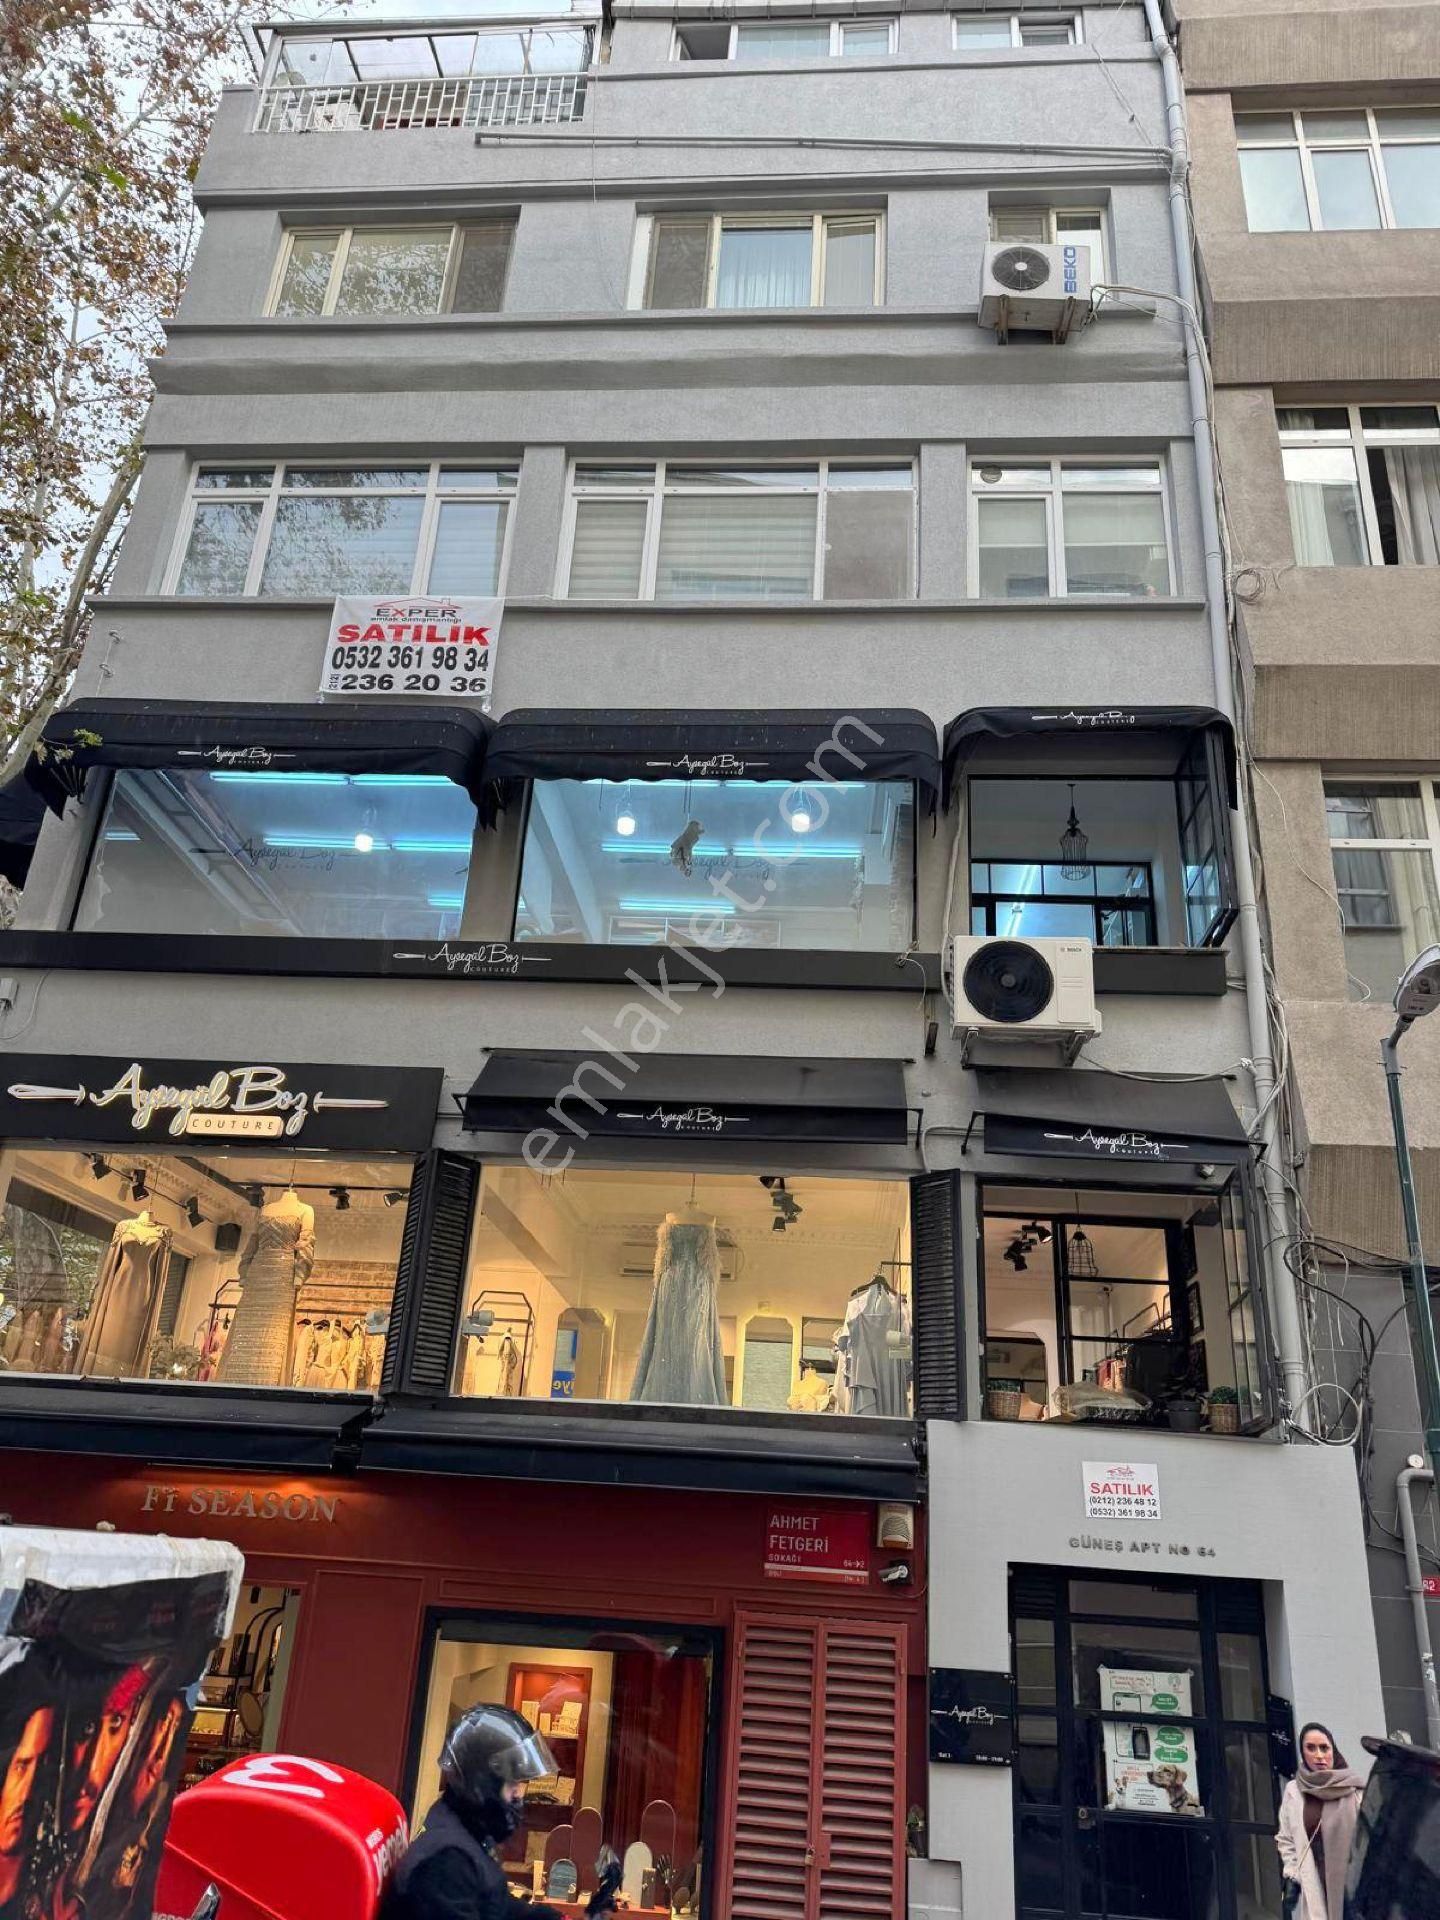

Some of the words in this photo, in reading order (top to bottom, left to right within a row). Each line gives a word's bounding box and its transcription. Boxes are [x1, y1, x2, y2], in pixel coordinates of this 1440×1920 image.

[1063, 246, 1077, 293] BEKO
[376, 608, 457, 618] EXPER
[337, 623, 492, 647] SATILIK
[331, 645, 383, 670] 0532
[387, 645, 424, 669] 361
[431, 646, 458, 671] 98
[463, 647, 490, 672] 34
[341, 673, 394, 691] 236
[403, 673, 441, 691] 20
[450, 676, 487, 693] 36
[485, 943, 519, 974] Boz
[227, 1065, 309, 1136] Boz
[191, 1118, 275, 1130] COUTURE
[1090, 1482, 1154, 1496] SATILIK
[187, 1486, 344, 1523] SEASON
[1089, 1495, 1116, 1506] (0212)
[1116, 1497, 1133, 1506] 236
[1147, 1498, 1157, 1507] 12
[769, 1514, 821, 1531] AHMET
[1090, 1507, 1116, 1518] (0532)
[1117, 1508, 1133, 1517] 361
[769, 1534, 829, 1553] FETGERİ
[1068, 1534, 1124, 1554] GÜNEŞ
[1129, 1541, 1161, 1554] APT
[1197, 1546, 1216, 1558] 64
